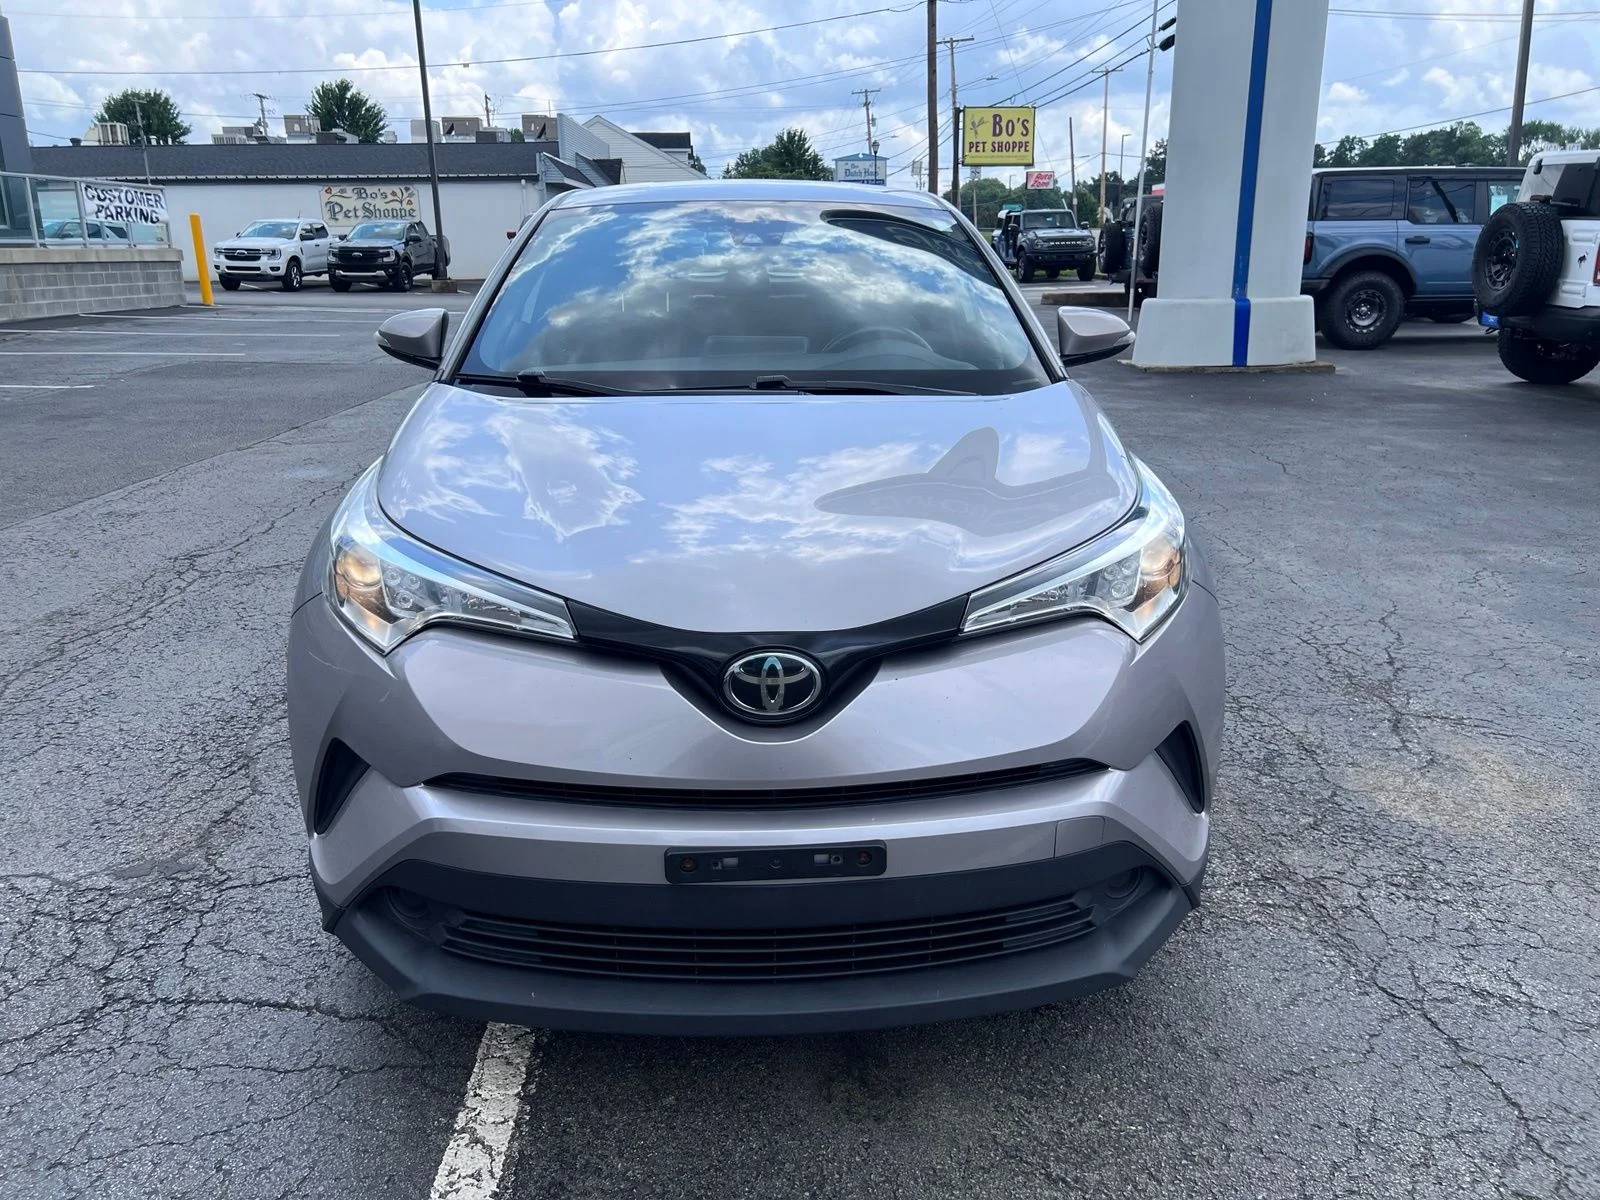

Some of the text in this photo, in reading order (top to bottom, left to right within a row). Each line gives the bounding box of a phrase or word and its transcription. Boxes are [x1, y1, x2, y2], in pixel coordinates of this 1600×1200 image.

[992, 113, 1030, 137] Bo's
[968, 141, 1030, 153] PET SHOPPE
[84, 184, 166, 209] CUSTOMER
[352, 187, 388, 200] Bo's
[95, 204, 160, 224] PARKING
[325, 201, 417, 221] Pet Shoppe
